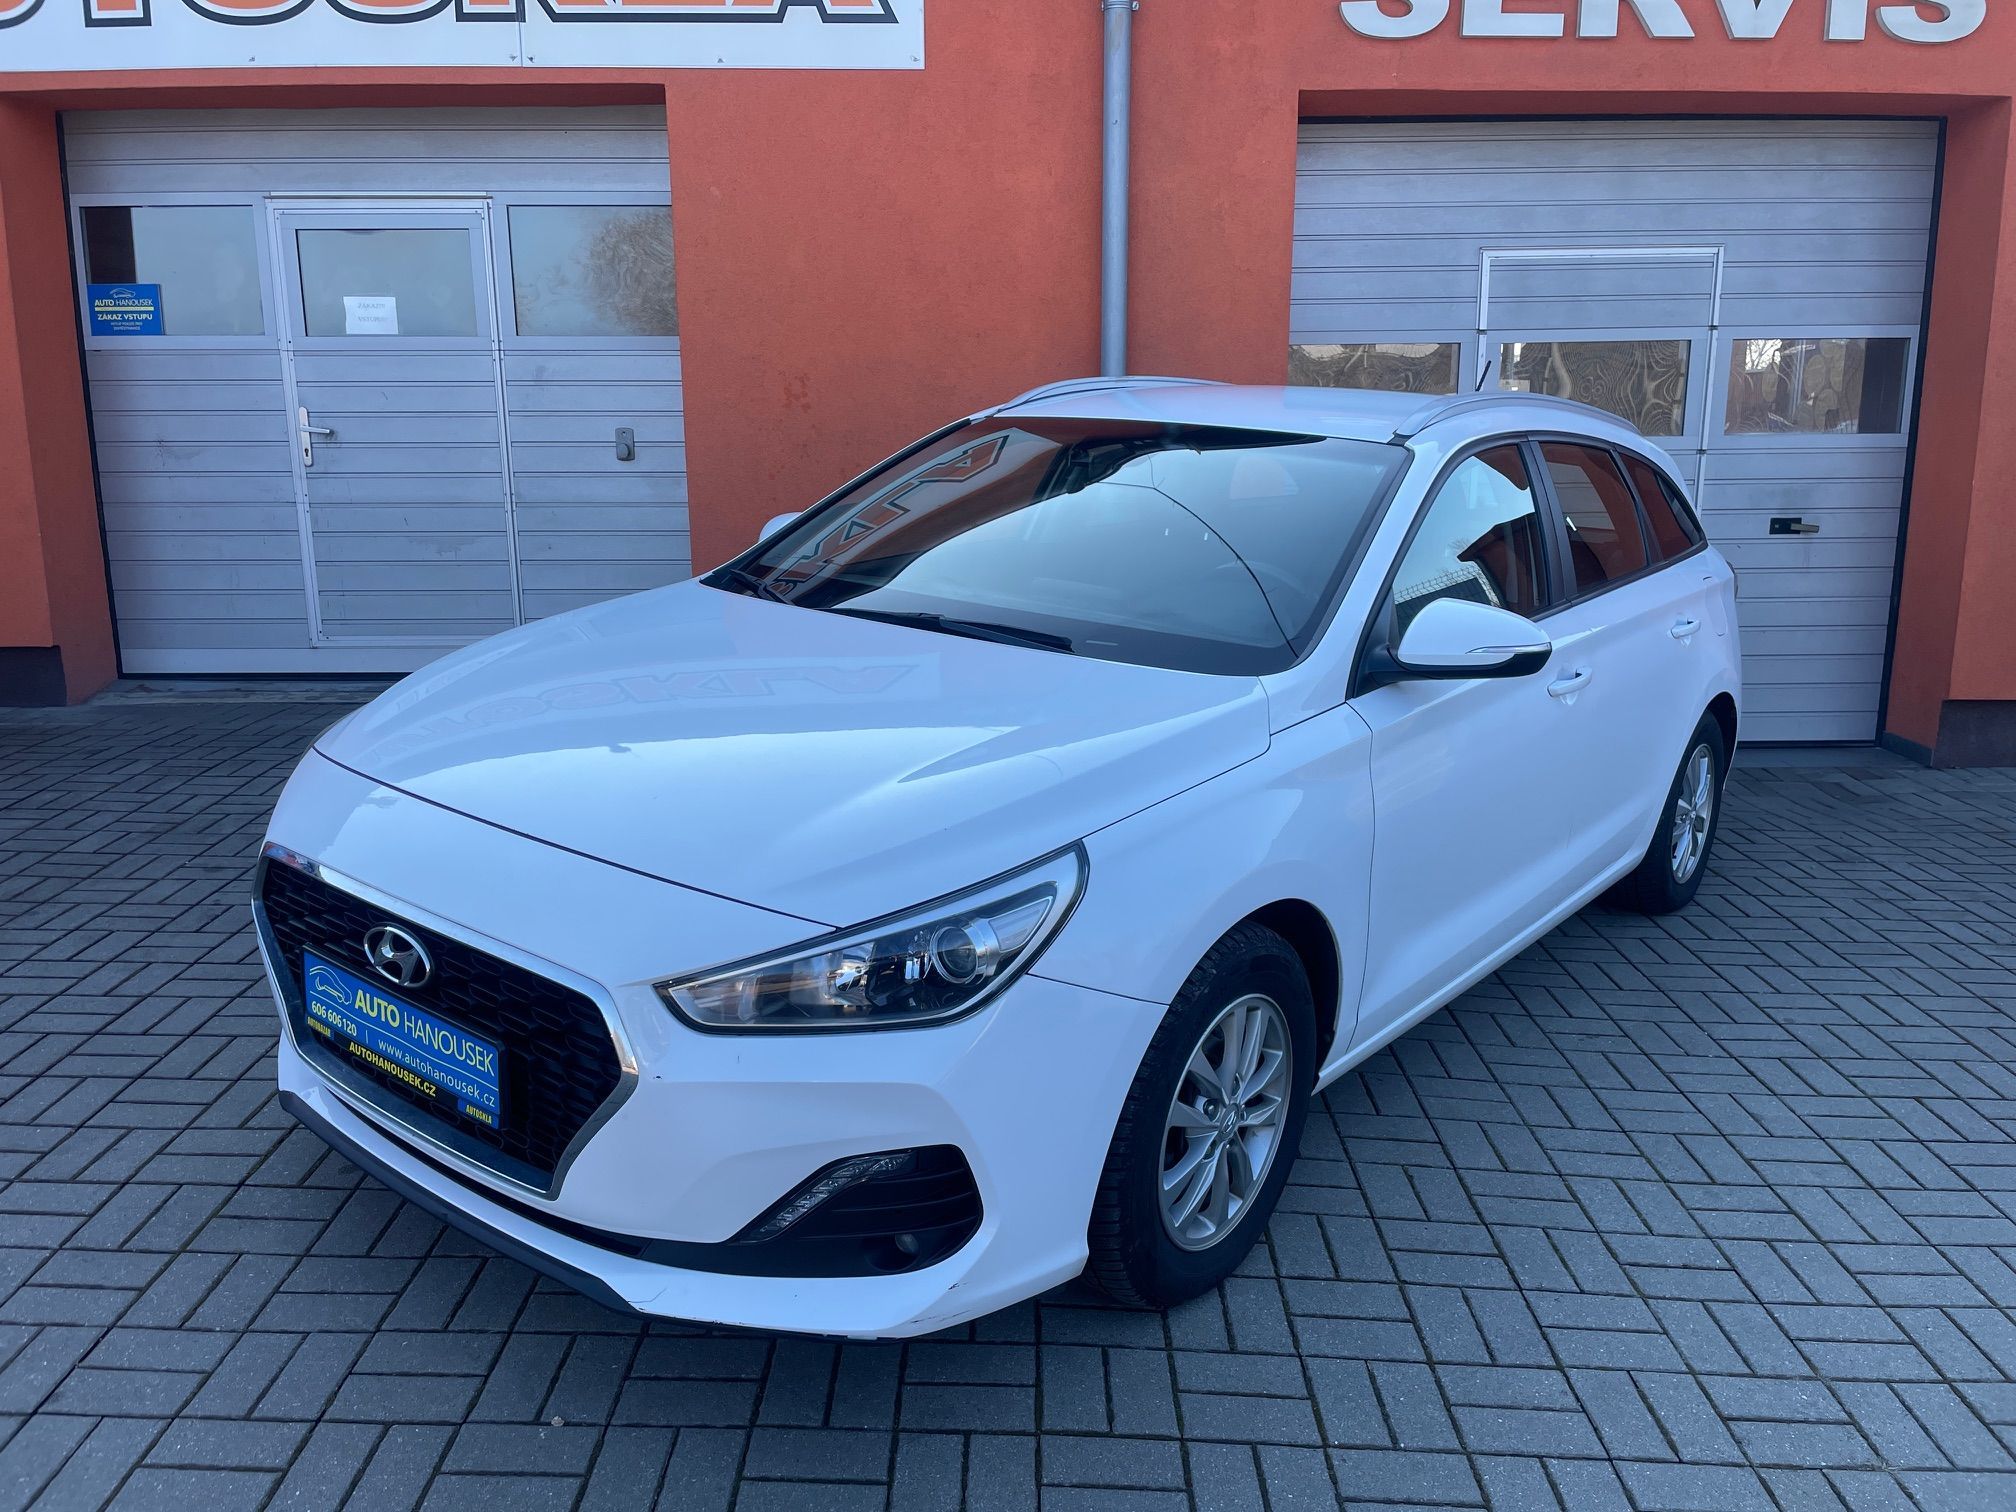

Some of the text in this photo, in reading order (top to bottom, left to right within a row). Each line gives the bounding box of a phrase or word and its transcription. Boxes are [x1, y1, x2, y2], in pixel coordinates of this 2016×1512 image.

[311, 1000, 358, 1037] 606 606 120
[354, 988, 496, 1077] AUTO HANOUSEK
[349, 1041, 437, 1097] AUTOHANOUSEK.CZ
[378, 1038, 496, 1108] www.autohanousek.cz
[465, 1103, 493, 1125] AUTOSKLA
